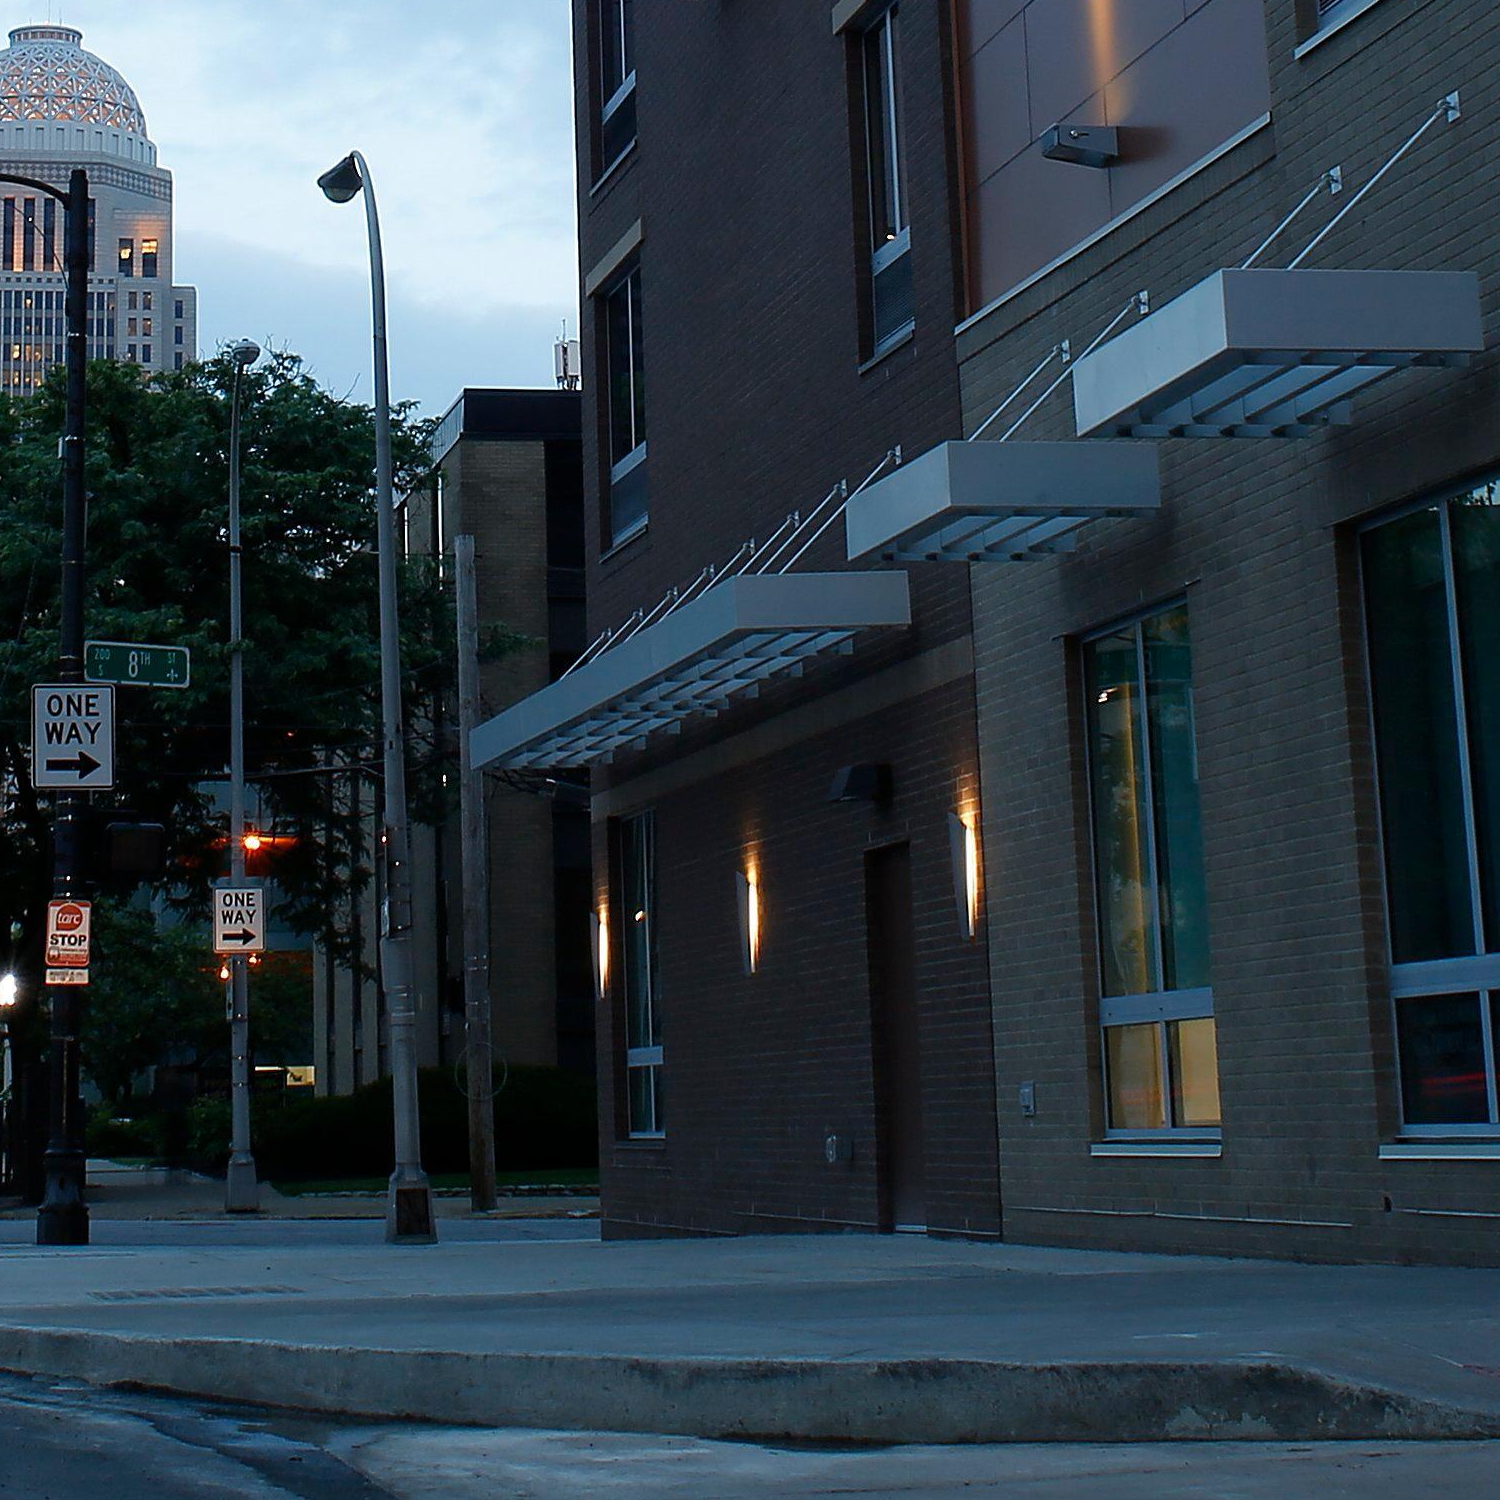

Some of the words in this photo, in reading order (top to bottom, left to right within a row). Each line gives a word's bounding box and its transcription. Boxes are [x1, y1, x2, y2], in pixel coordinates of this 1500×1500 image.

[46, 693, 100, 717] ONE
[44, 721, 102, 745] WAY
[222, 892, 256, 907] ONE
[57, 912, 82, 925] tarc
[221, 909, 257, 925] WAY
[49, 933, 87, 947] STOP
